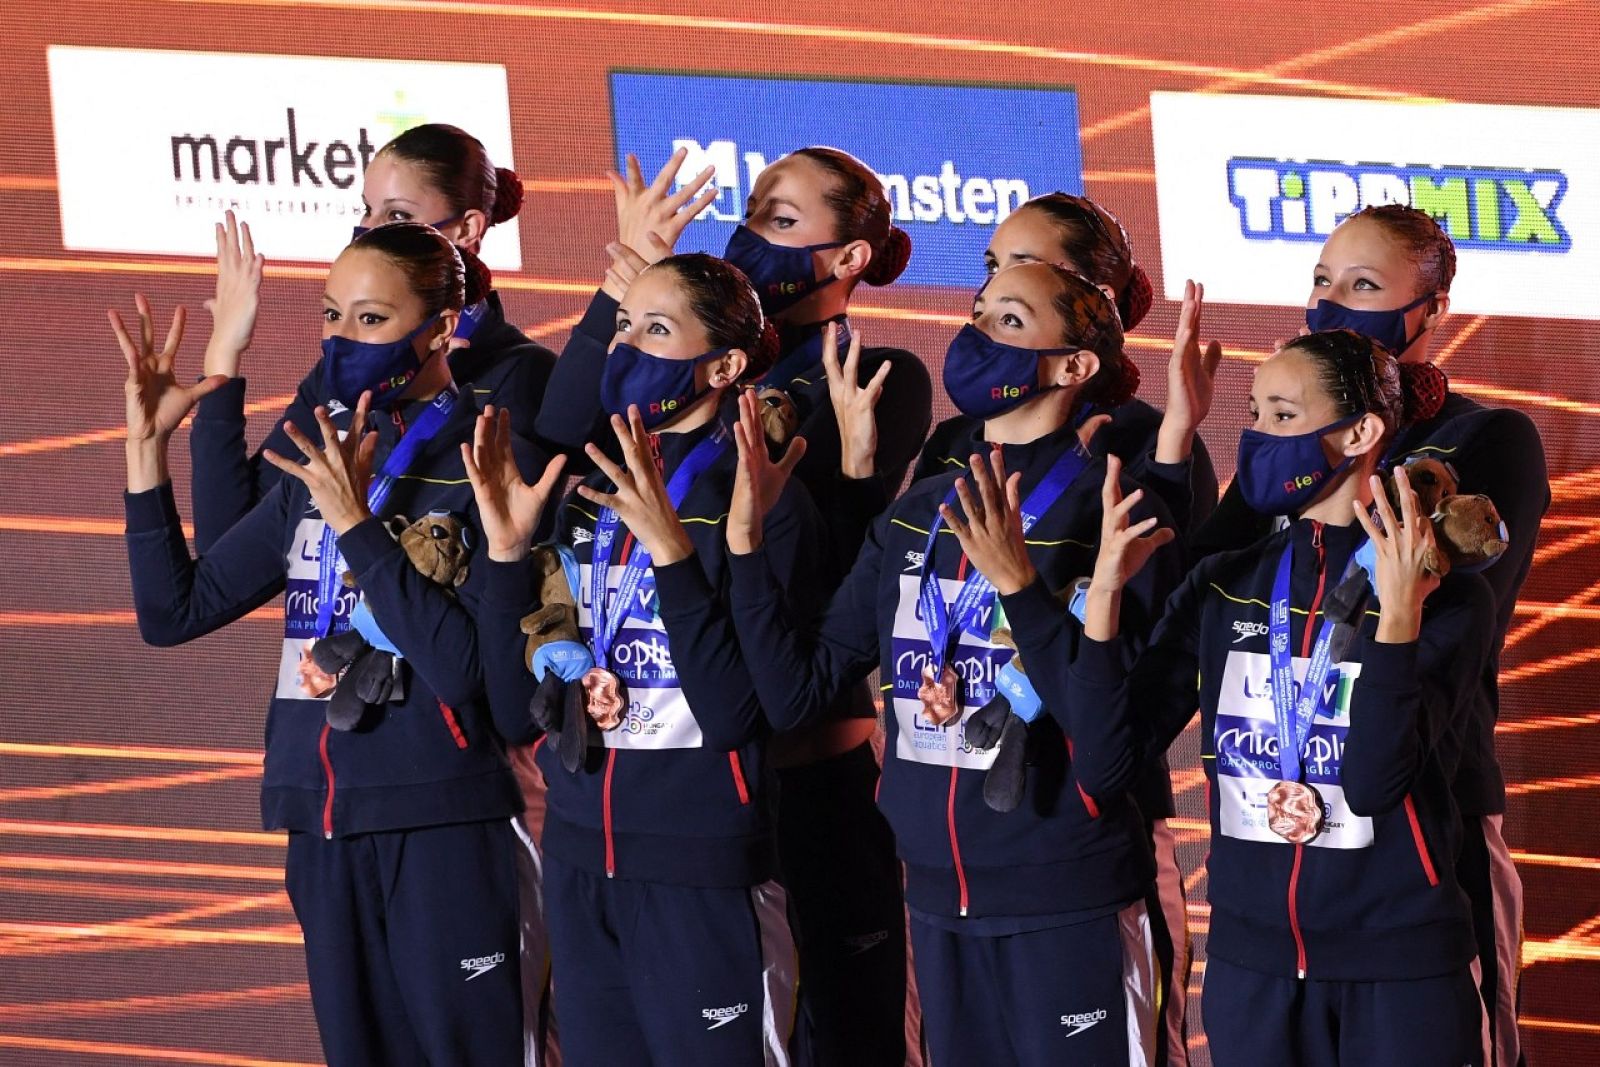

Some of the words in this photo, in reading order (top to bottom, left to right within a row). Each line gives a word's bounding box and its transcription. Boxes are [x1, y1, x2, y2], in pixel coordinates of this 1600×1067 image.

[171, 107, 375, 189] market
[1284, 470, 1323, 494] Rfen
[1231, 620, 1270, 635] speedo
[460, 951, 505, 971] speedo
[701, 1002, 749, 1020] speedo
[1060, 1007, 1107, 1027] speedo
